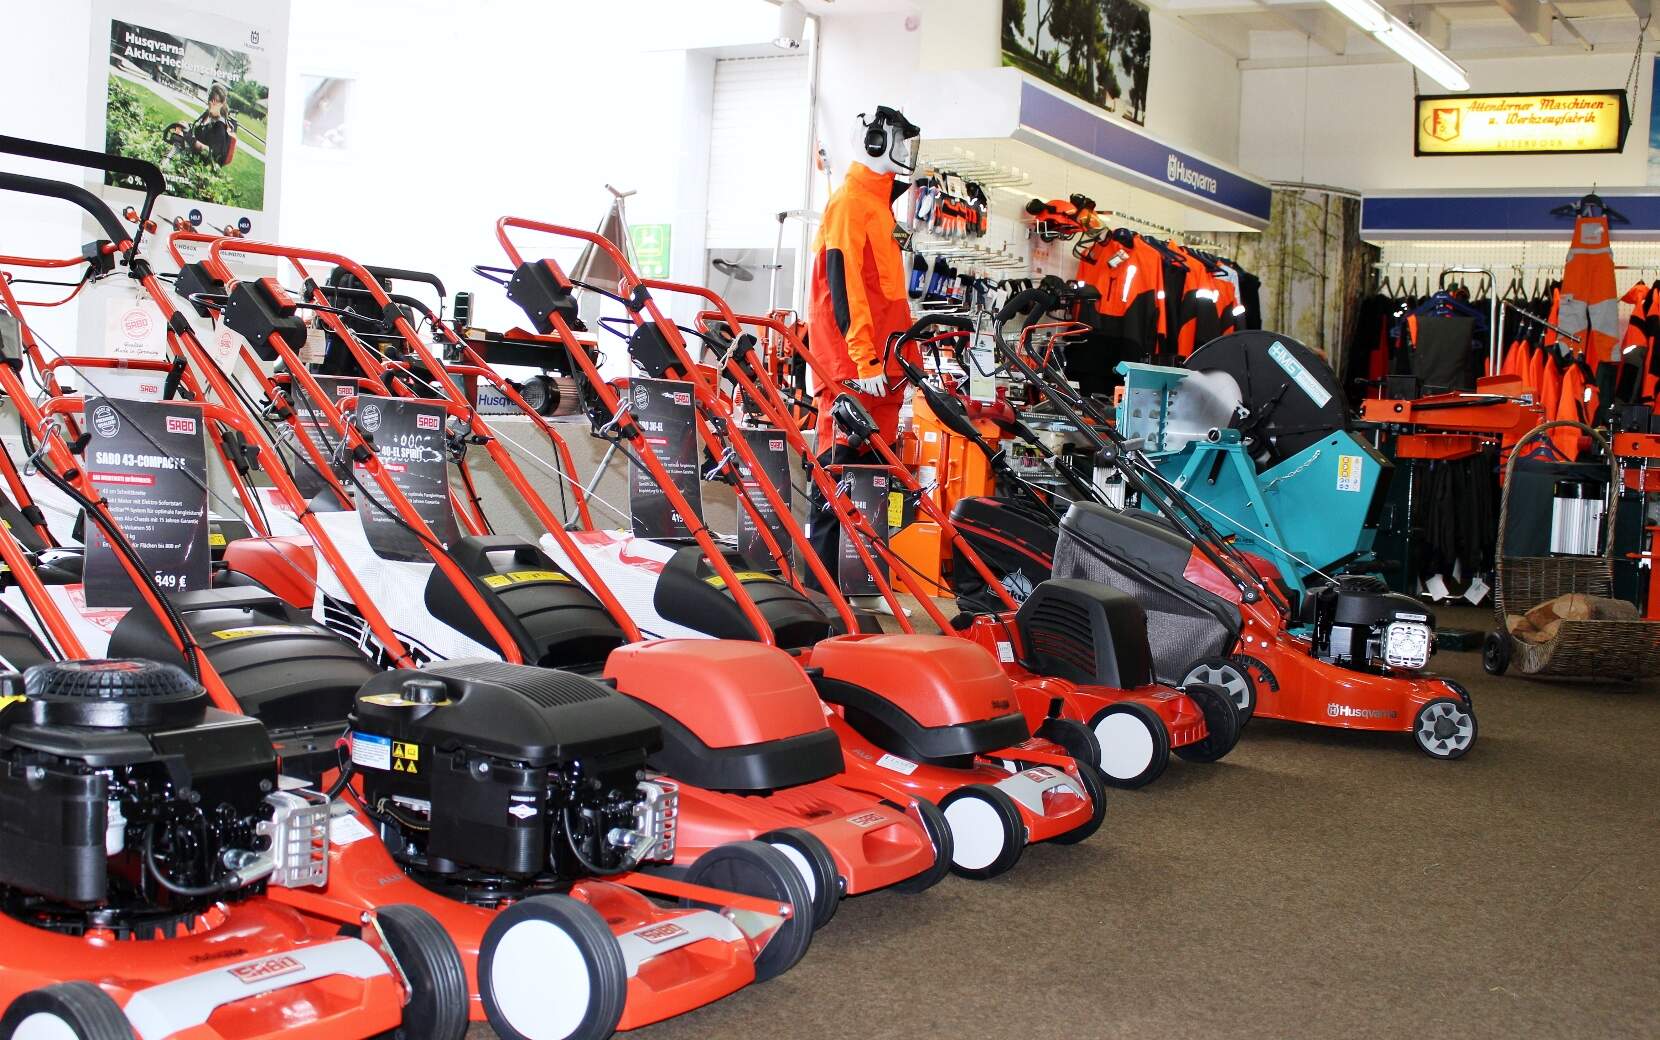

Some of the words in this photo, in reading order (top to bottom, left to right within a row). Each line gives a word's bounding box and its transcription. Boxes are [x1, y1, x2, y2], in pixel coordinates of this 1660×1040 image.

[125, 31, 185, 56] Husqvarna
[124, 46, 241, 82] Akku-Heckenscheren
[1467, 100, 1534, 111] Attendorner
[1505, 114, 1596, 126] Werkzeugfabrik
[1176, 161, 1217, 194] Husqvarna
[168, 420, 194, 432] SABO
[418, 417, 438, 429] SABO
[96, 451, 121, 466] SABO
[178, 575, 187, 587] €
[1339, 705, 1398, 720] Husqvarna
